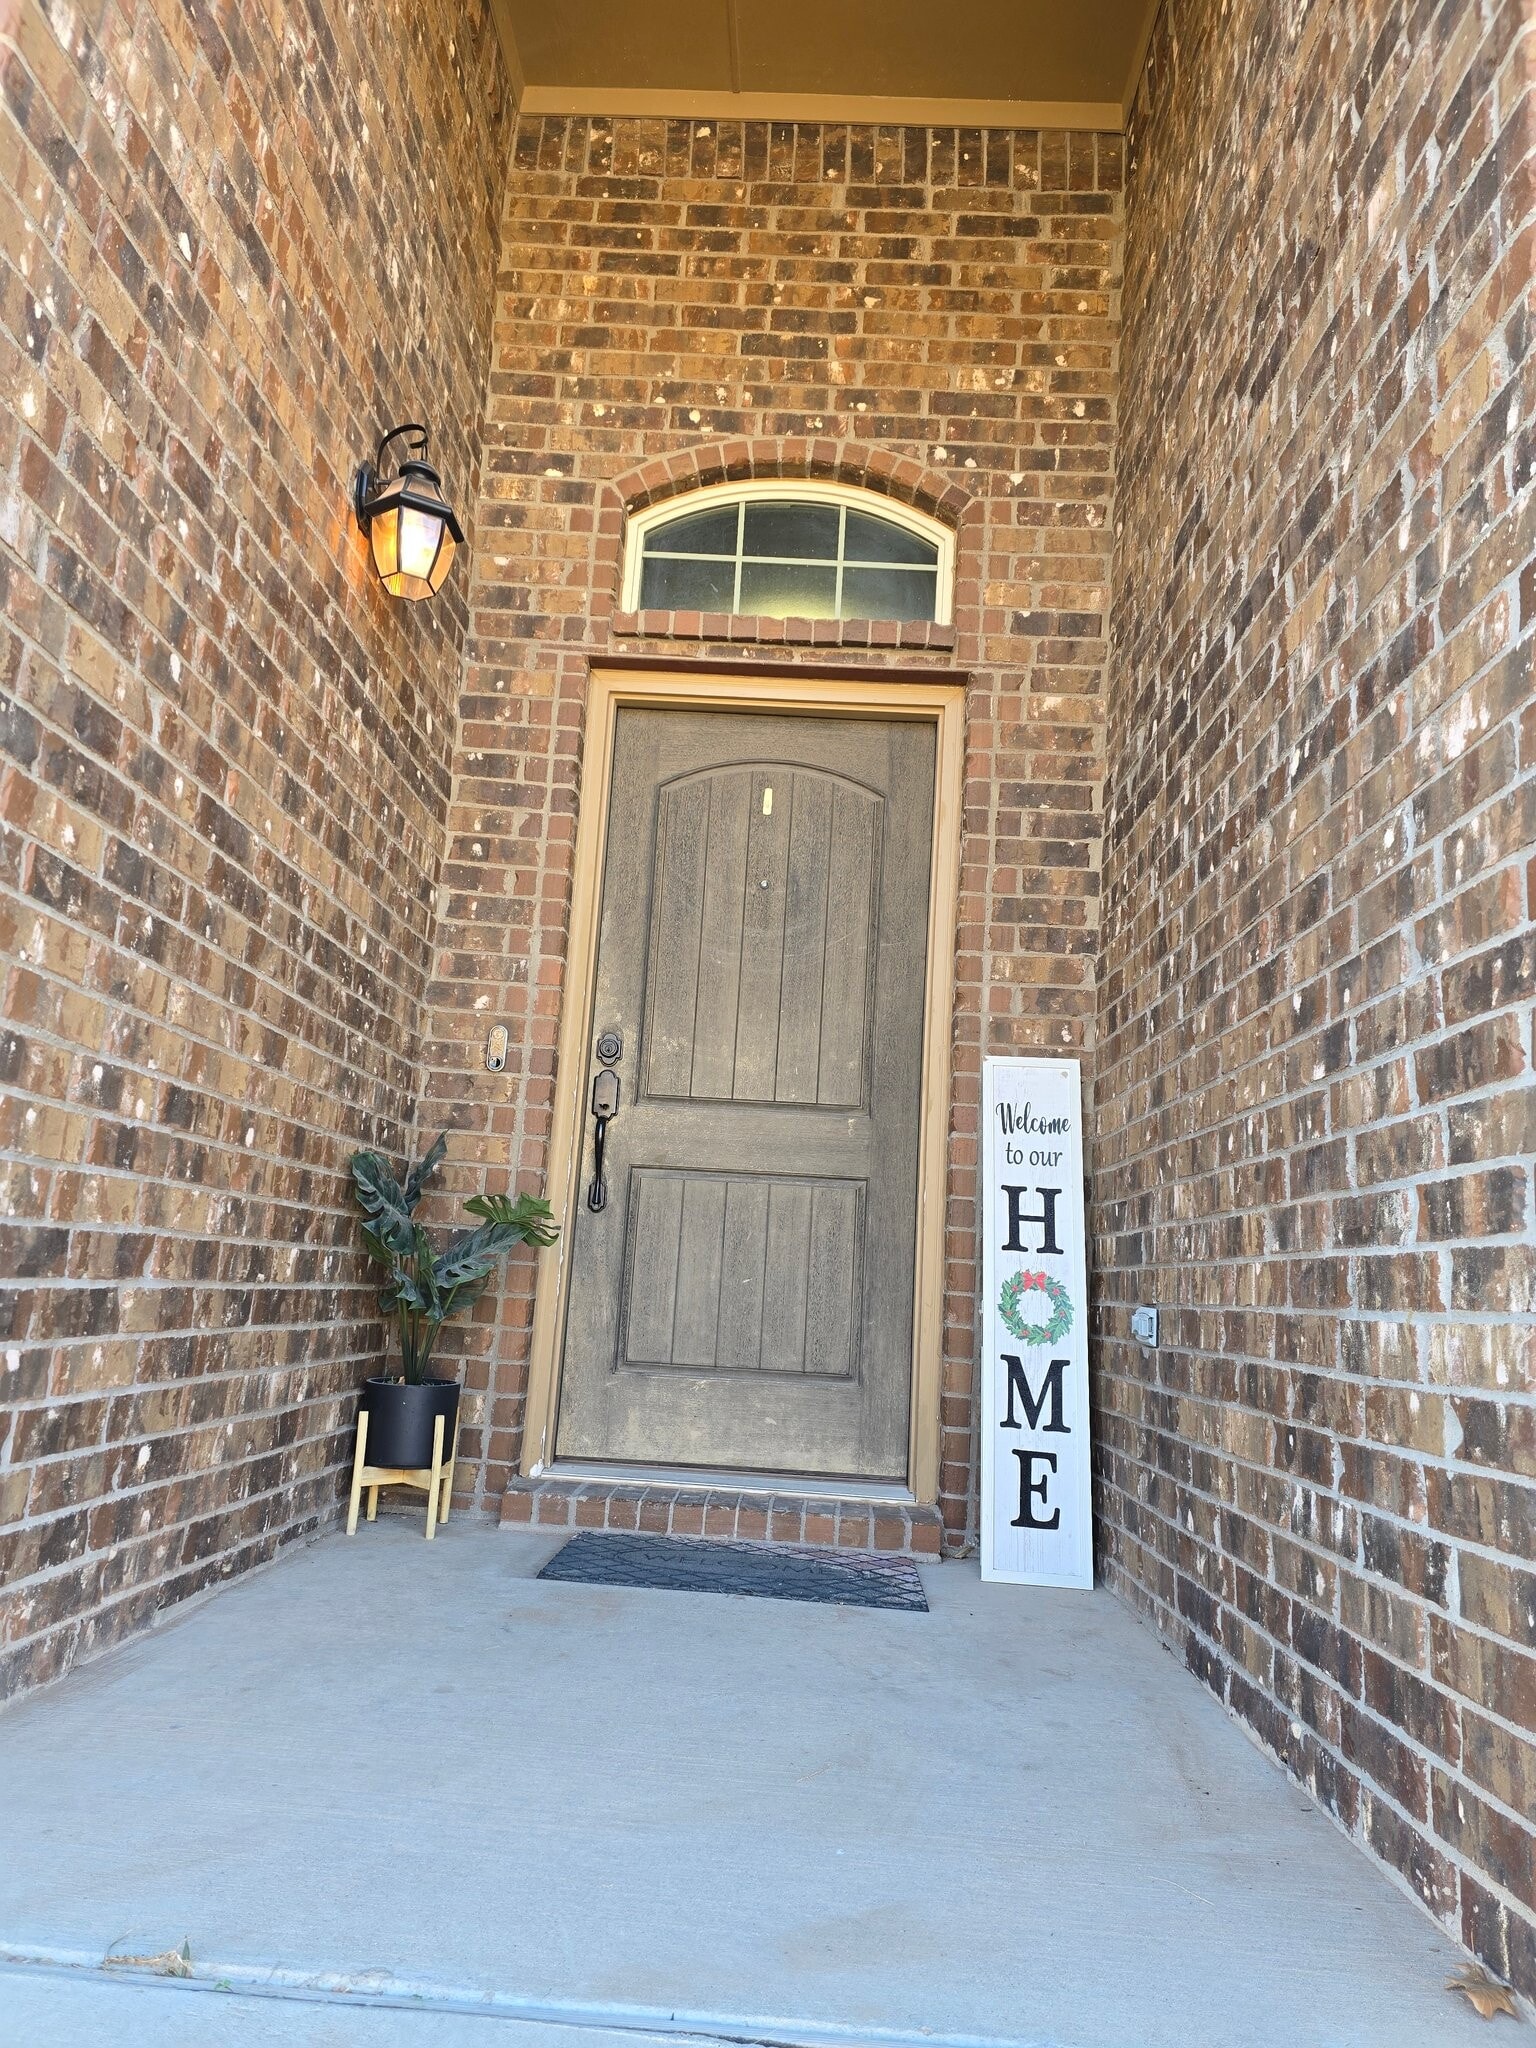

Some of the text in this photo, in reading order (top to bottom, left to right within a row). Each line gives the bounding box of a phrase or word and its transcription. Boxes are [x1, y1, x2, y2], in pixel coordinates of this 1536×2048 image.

[995, 1101, 1071, 1135] Welcome
[1005, 1142, 1063, 1167] to our
[644, 1552, 836, 1576] WELCOME
